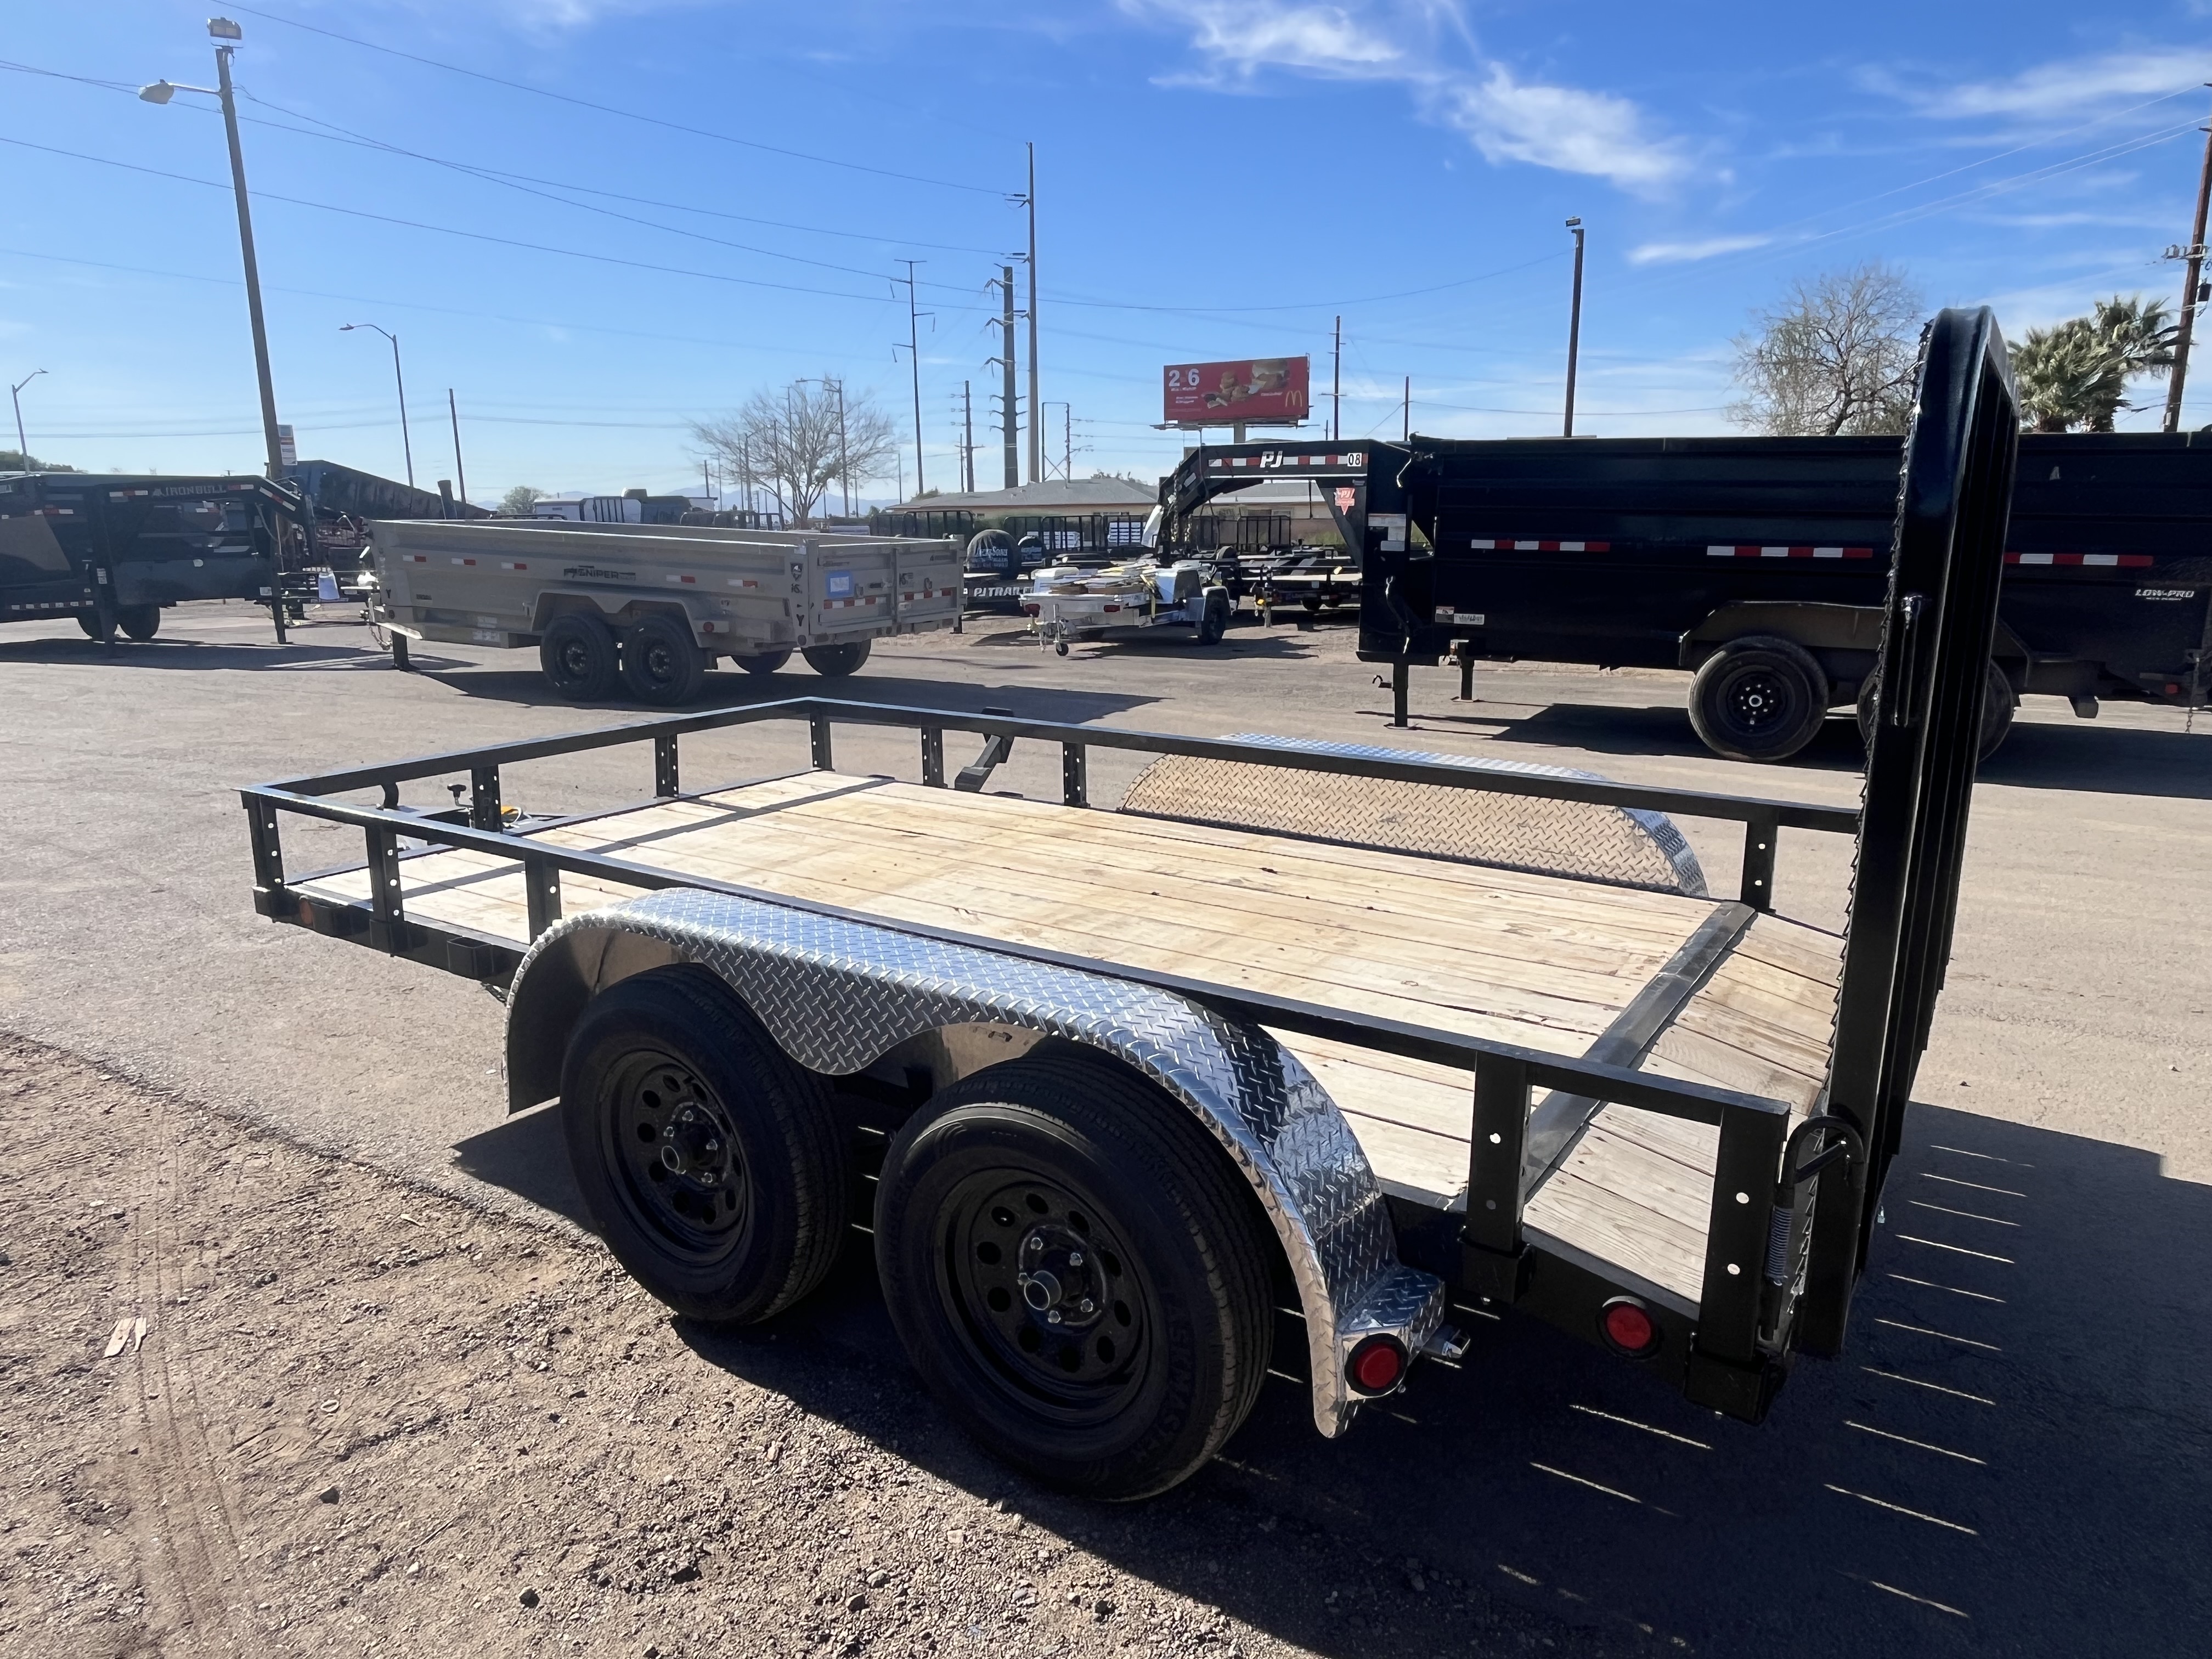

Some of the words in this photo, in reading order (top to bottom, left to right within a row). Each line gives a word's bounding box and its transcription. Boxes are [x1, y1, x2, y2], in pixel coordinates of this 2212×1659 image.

[1169, 370, 1180, 386] 2
[1188, 368, 1200, 386] 6
[1260, 450, 1283, 468] PJ
[1348, 453, 1361, 466] 08
[974, 588, 987, 597] PJ
[2135, 589, 2194, 598] LOW-PRO
